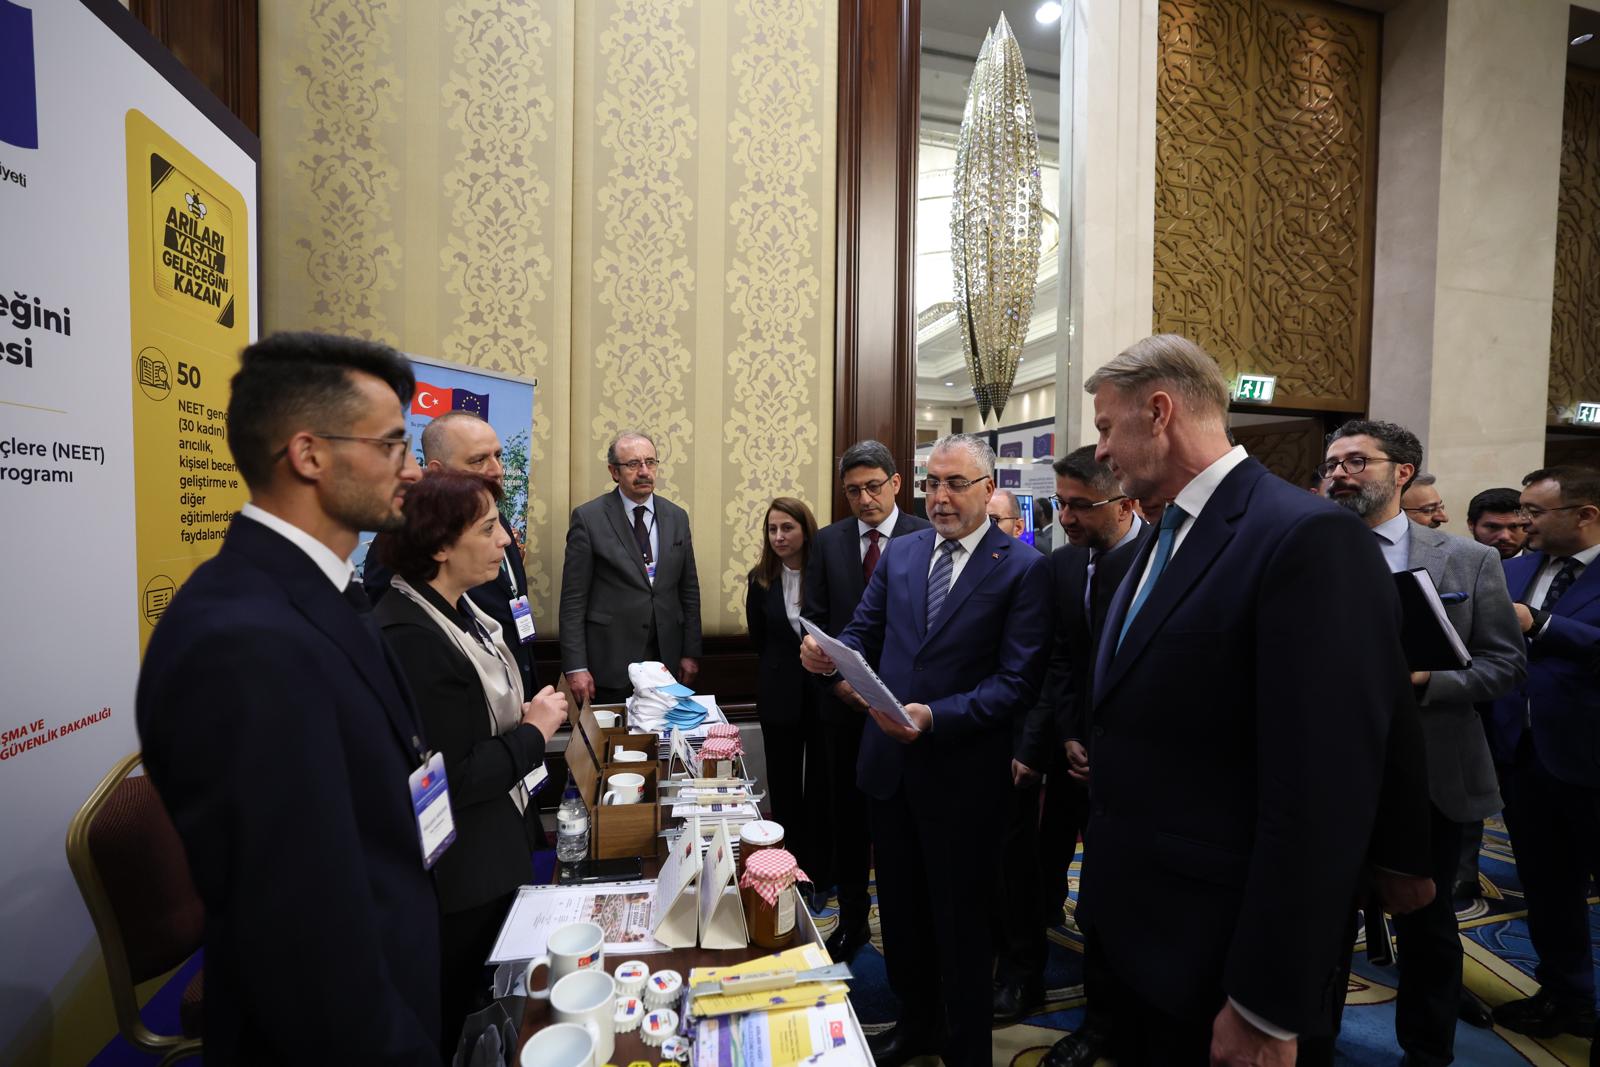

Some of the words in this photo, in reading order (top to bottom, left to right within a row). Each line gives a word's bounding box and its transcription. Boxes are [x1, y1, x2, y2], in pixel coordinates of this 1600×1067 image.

[165, 206, 225, 252] ARILARI
[173, 272, 222, 308] KAZAN
[0, 337, 33, 368] si
[176, 361, 201, 389] 50
[178, 399, 205, 416] NEET
[178, 417, 195, 433] (30
[196, 420, 225, 440] kadın)
[52, 441, 105, 465] (NEET)
[179, 455, 209, 472] kişisel
[0, 466, 73, 485] rogramı
[179, 474, 227, 490] geliştirme
[228, 479, 239, 489] ve
[180, 492, 206, 508] diğer
[0, 728, 59, 761] GÜVENLİK
[60, 707, 112, 737] BAKANLIĞI
[1, 724, 28, 747] ŞMA
[29, 718, 45, 733] VE
